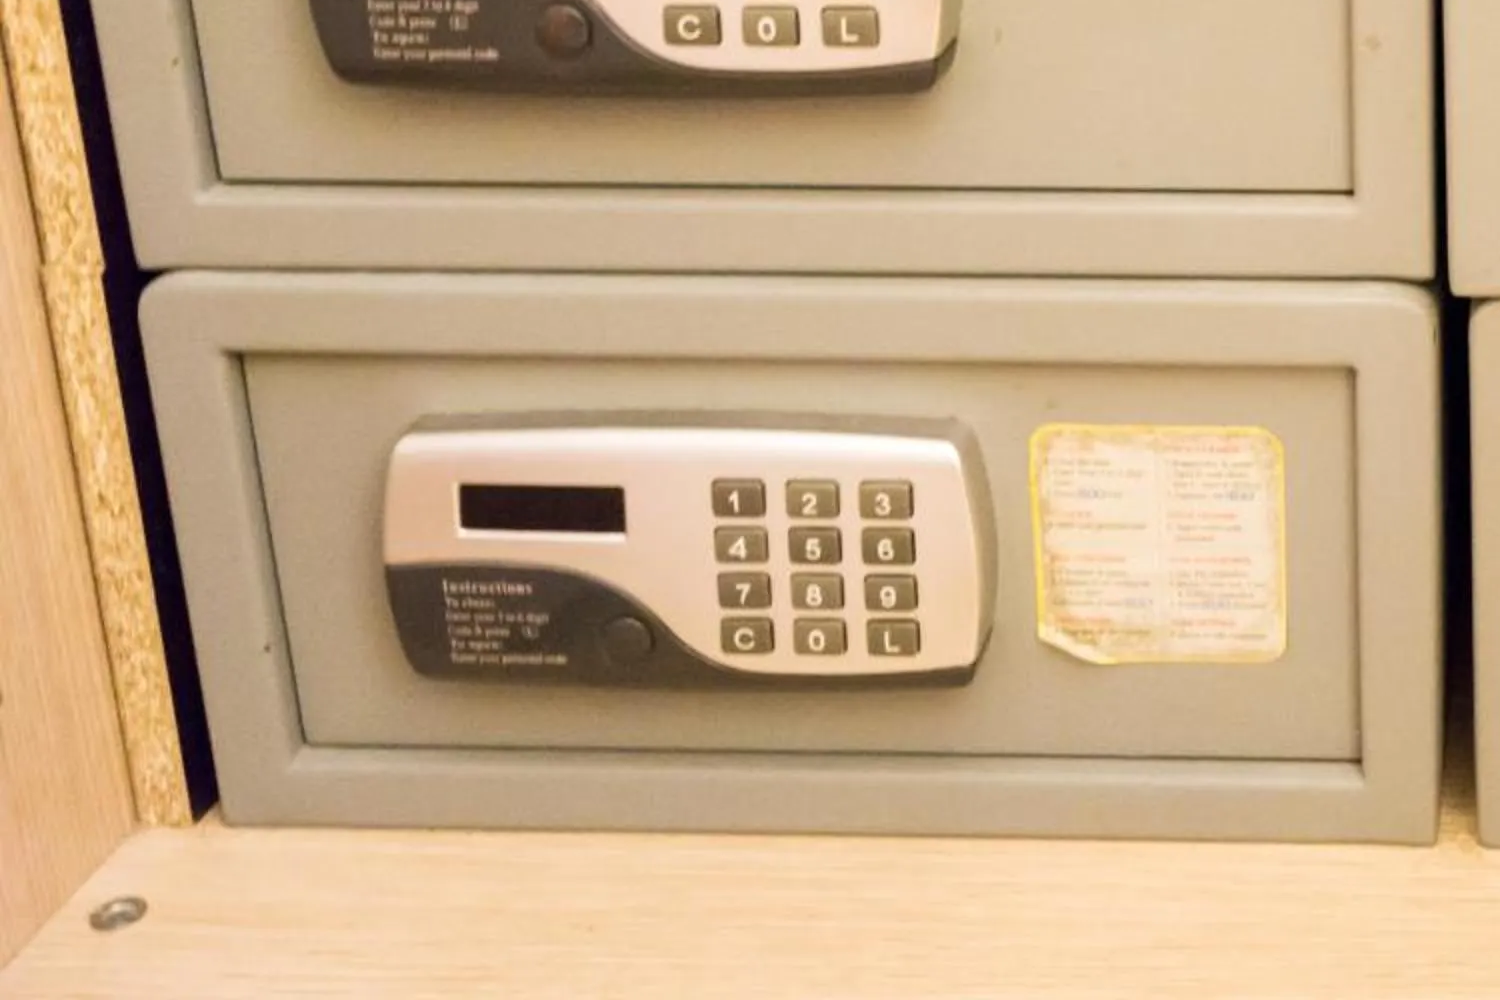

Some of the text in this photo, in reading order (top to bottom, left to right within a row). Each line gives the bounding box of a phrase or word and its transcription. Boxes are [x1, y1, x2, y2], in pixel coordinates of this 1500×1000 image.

[678, 14, 859, 42] C 0 L
[729, 490, 891, 515] 1 2 3
[729, 536, 894, 561] 4 5 6
[443, 578, 533, 595] Instructions
[736, 583, 896, 608] 7 8 9
[734, 628, 899, 653] C 0 L
